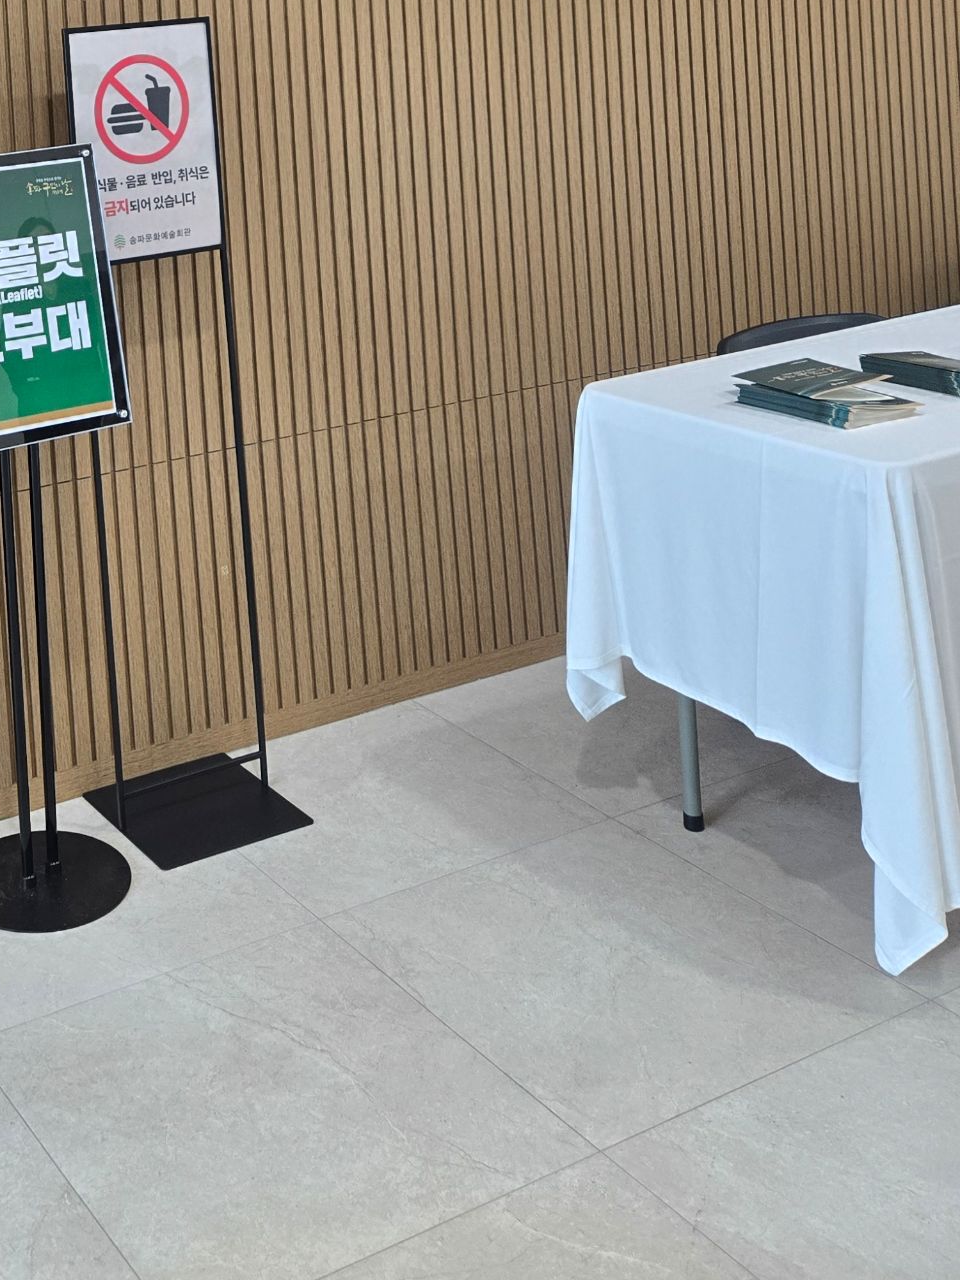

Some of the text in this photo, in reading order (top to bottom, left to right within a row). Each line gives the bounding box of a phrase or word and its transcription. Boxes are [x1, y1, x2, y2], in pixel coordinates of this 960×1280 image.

[151, 170, 177, 185] 반입,
[178, 165, 210, 182] 취식은
[104, 191, 196, 218] 금지되어 있습니다
[129, 227, 191, 246] 송파문화예술회관
